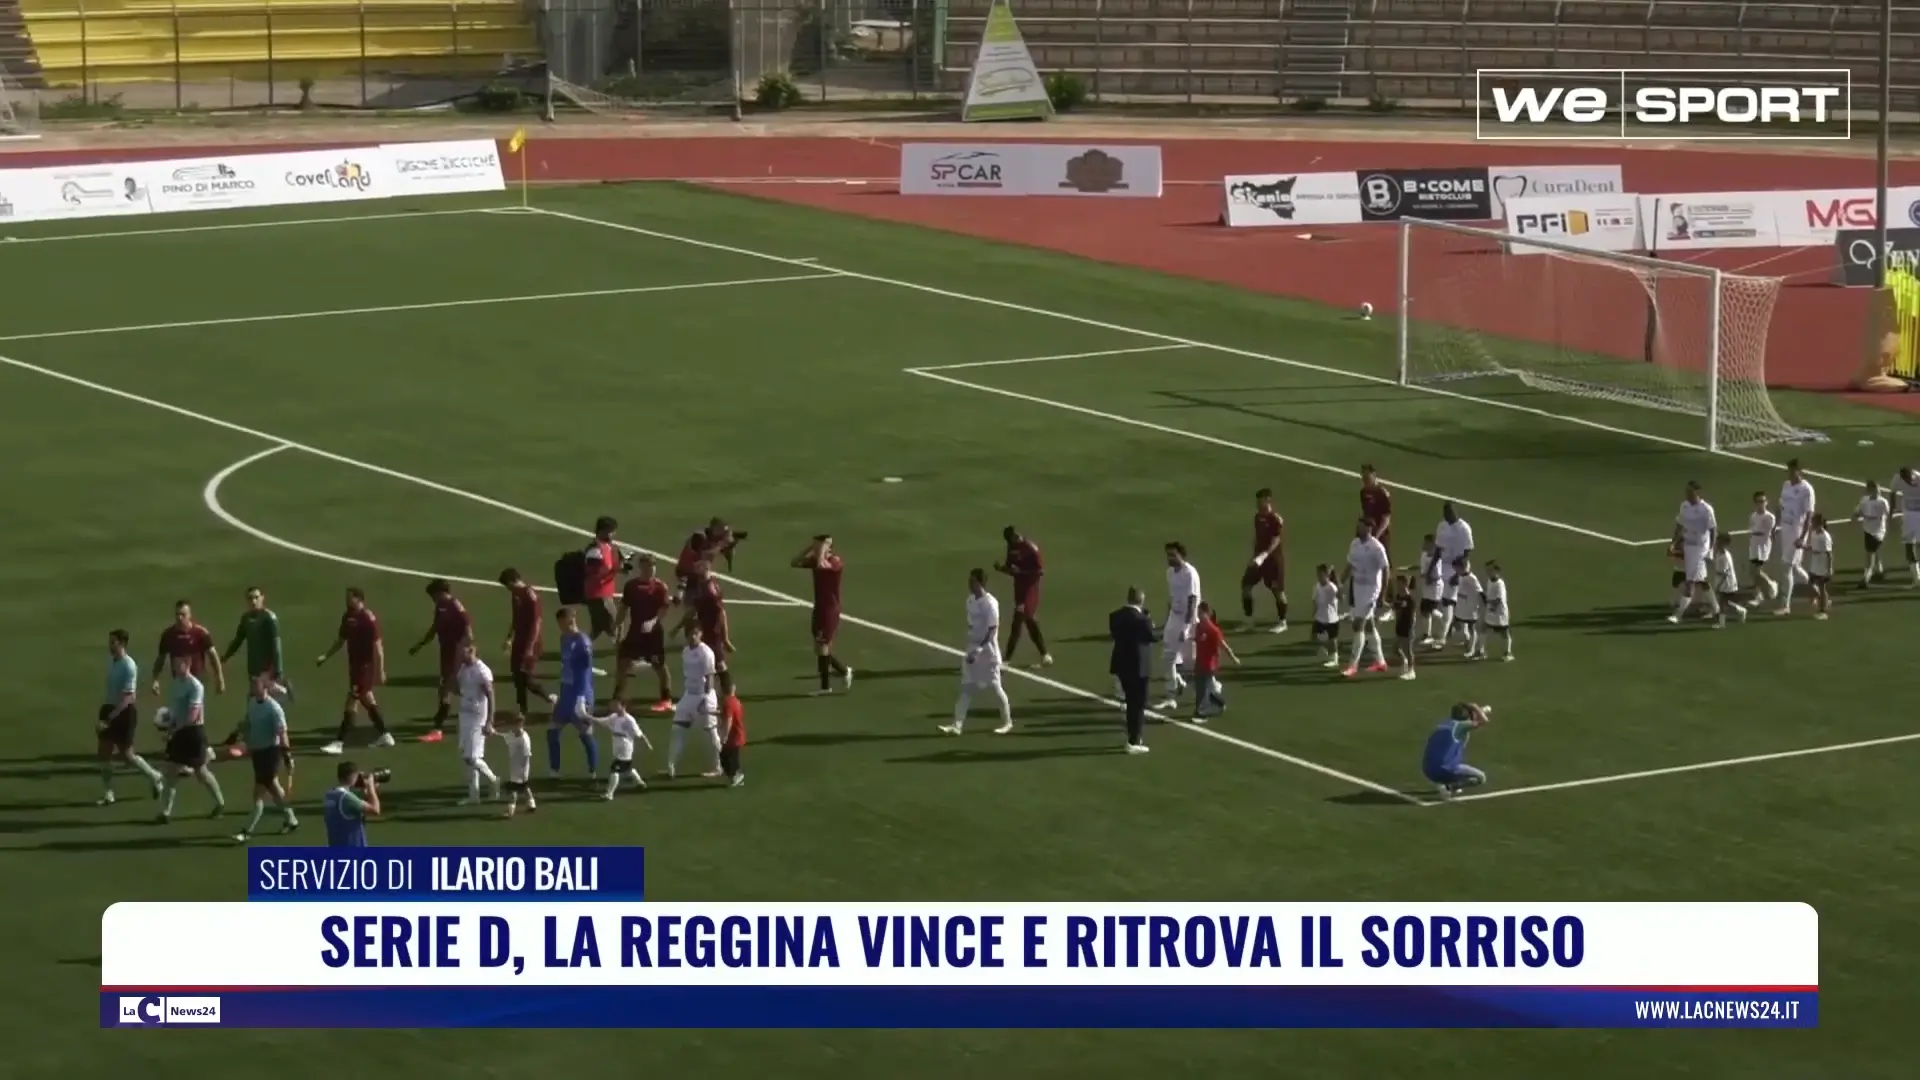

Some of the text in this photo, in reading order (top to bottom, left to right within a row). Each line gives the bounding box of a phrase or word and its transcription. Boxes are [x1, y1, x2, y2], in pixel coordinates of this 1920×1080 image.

[162, 180, 255, 194] PINO DI MARCO
[1532, 179, 1615, 193] CuraDent
[1806, 199, 1878, 228] MG
